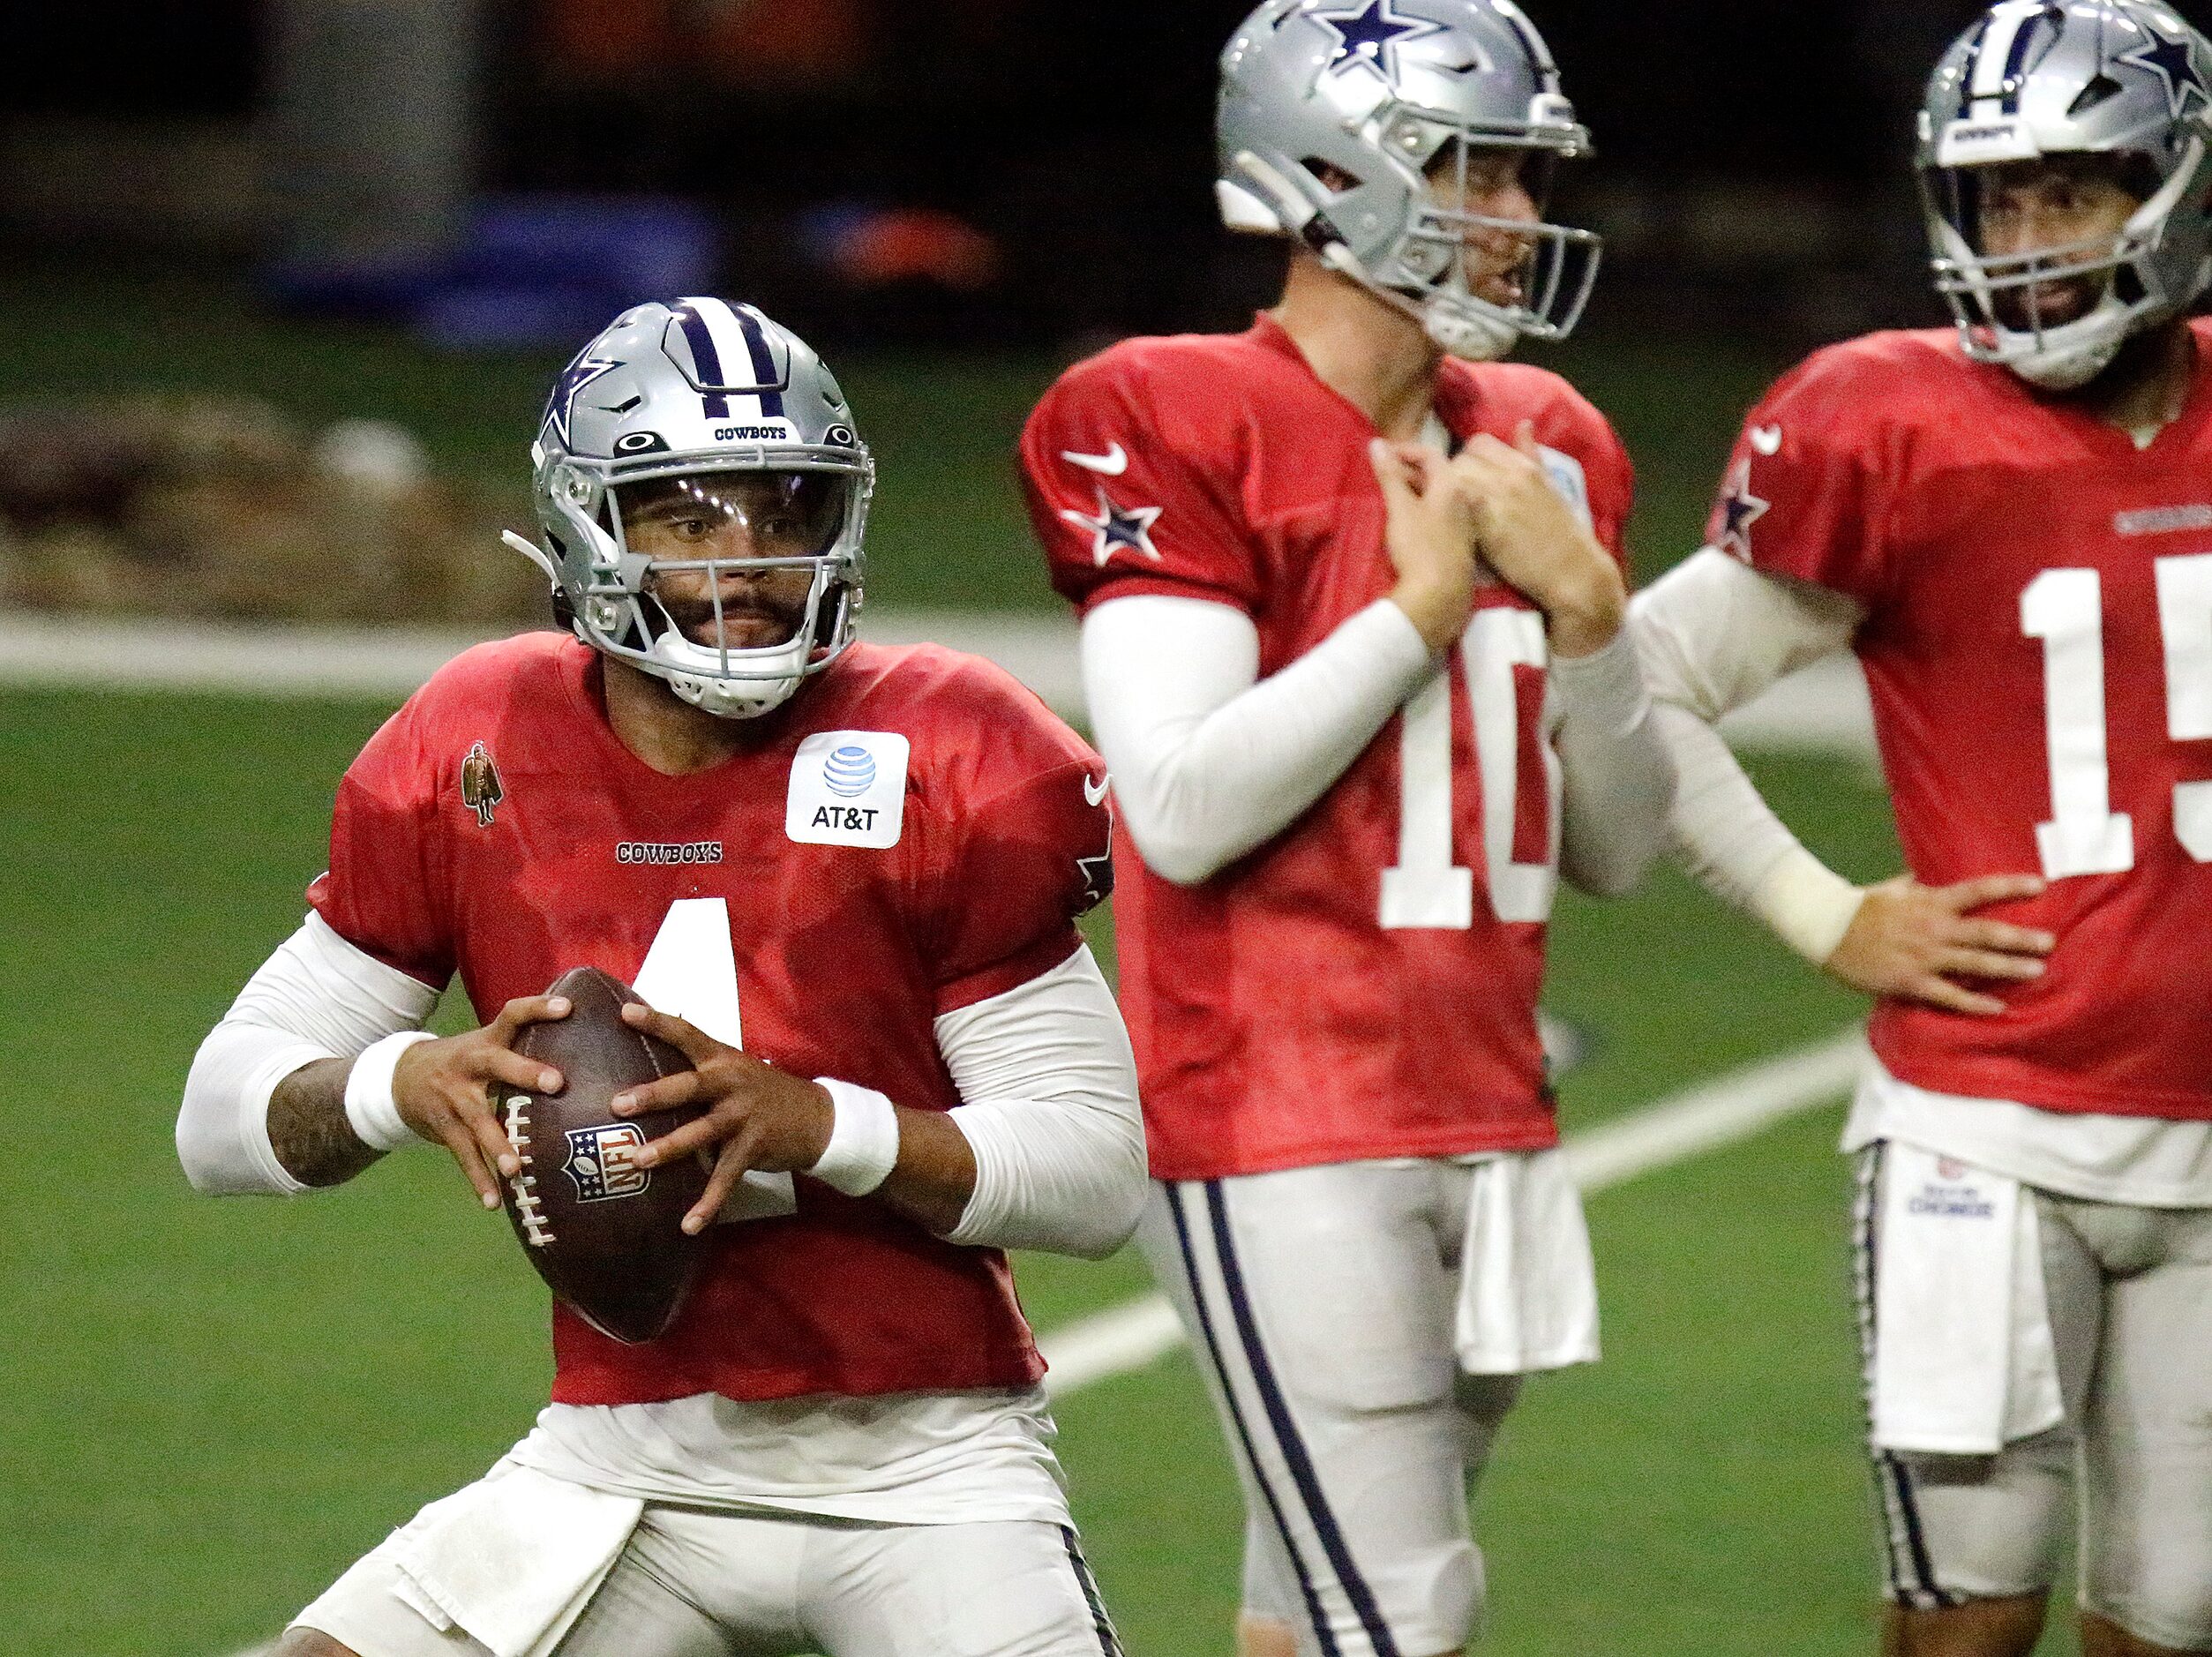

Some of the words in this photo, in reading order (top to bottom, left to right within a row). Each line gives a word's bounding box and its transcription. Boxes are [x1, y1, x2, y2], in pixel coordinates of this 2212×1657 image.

[715, 426, 787, 440] COWBOYS
[1379, 605, 1564, 929] 10
[812, 806, 880, 831] AT&T
[617, 842, 723, 865] COWBOYS
[601, 1130, 642, 1191] NFL
